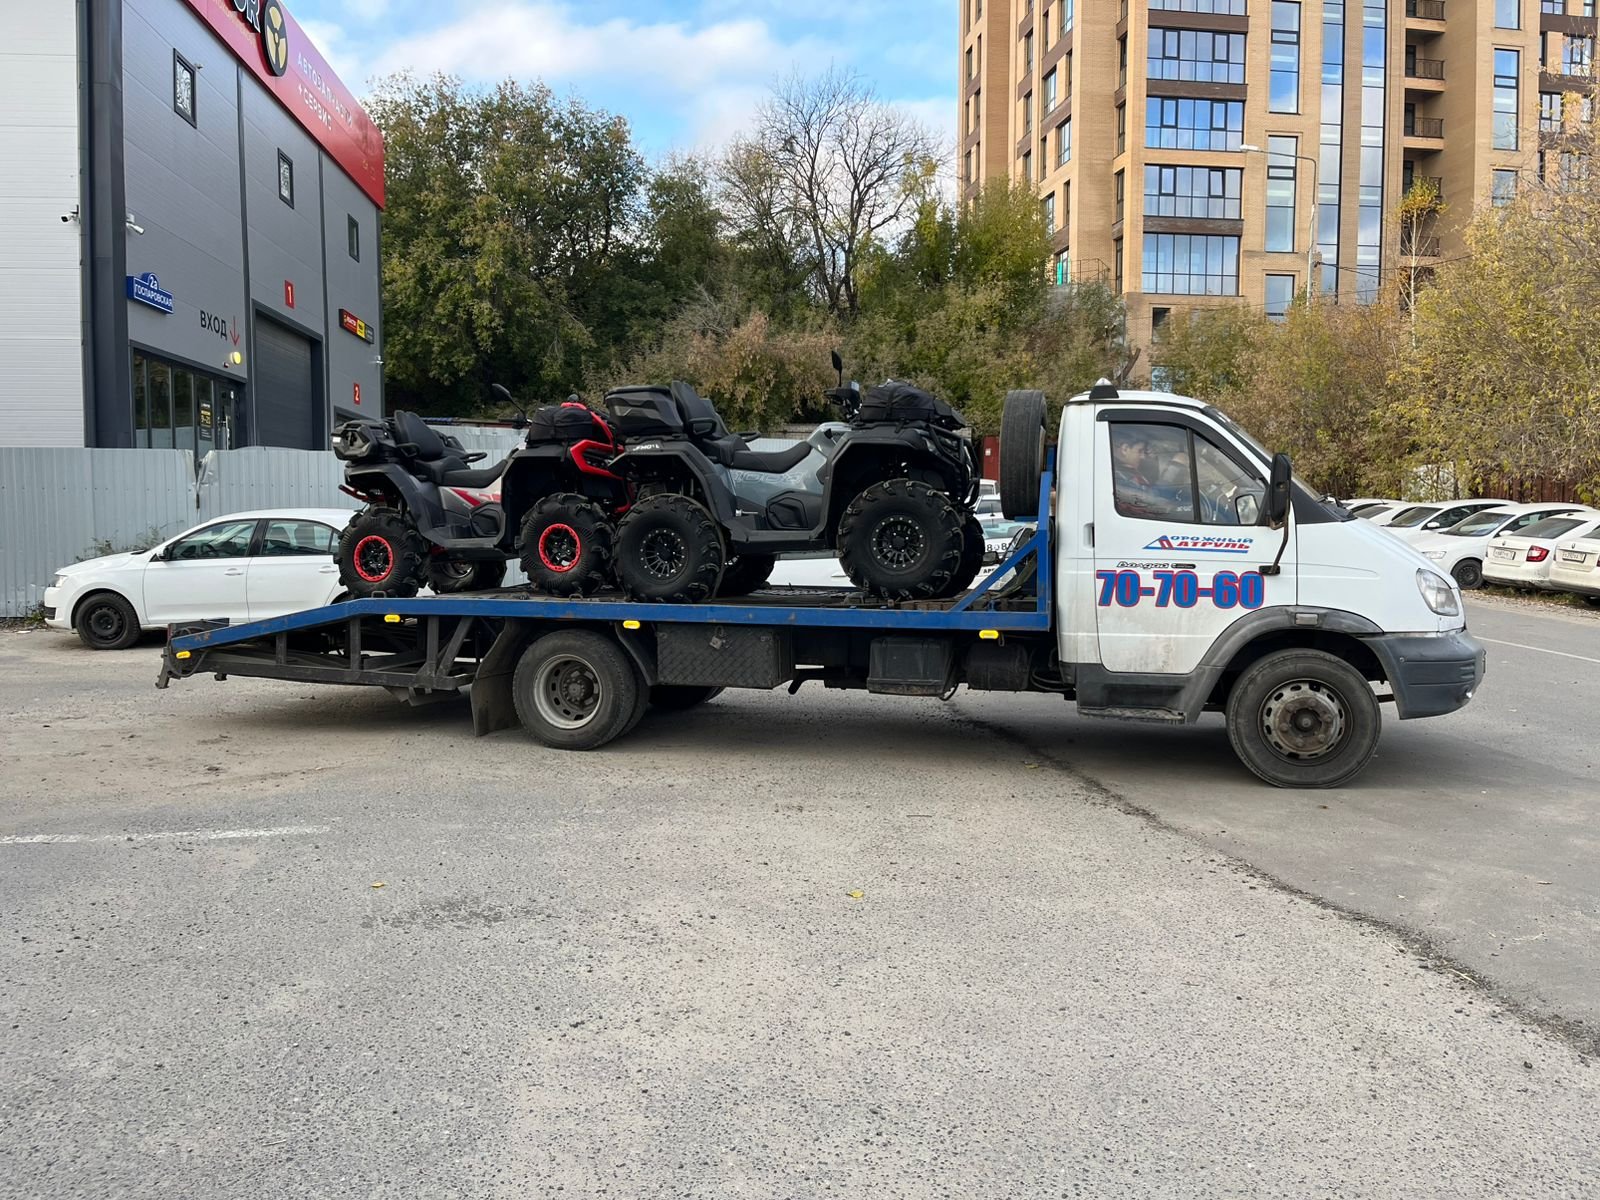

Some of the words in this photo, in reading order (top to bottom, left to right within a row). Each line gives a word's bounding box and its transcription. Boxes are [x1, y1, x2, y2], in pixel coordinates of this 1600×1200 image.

[134, 284, 173, 307] ГОСПАРОВСКАЯ
[287, 286, 292, 304] 1
[200, 309, 228, 341] ВХОД
[354, 385, 360, 401] 2
[1096, 569, 1265, 610] 70-70-60
